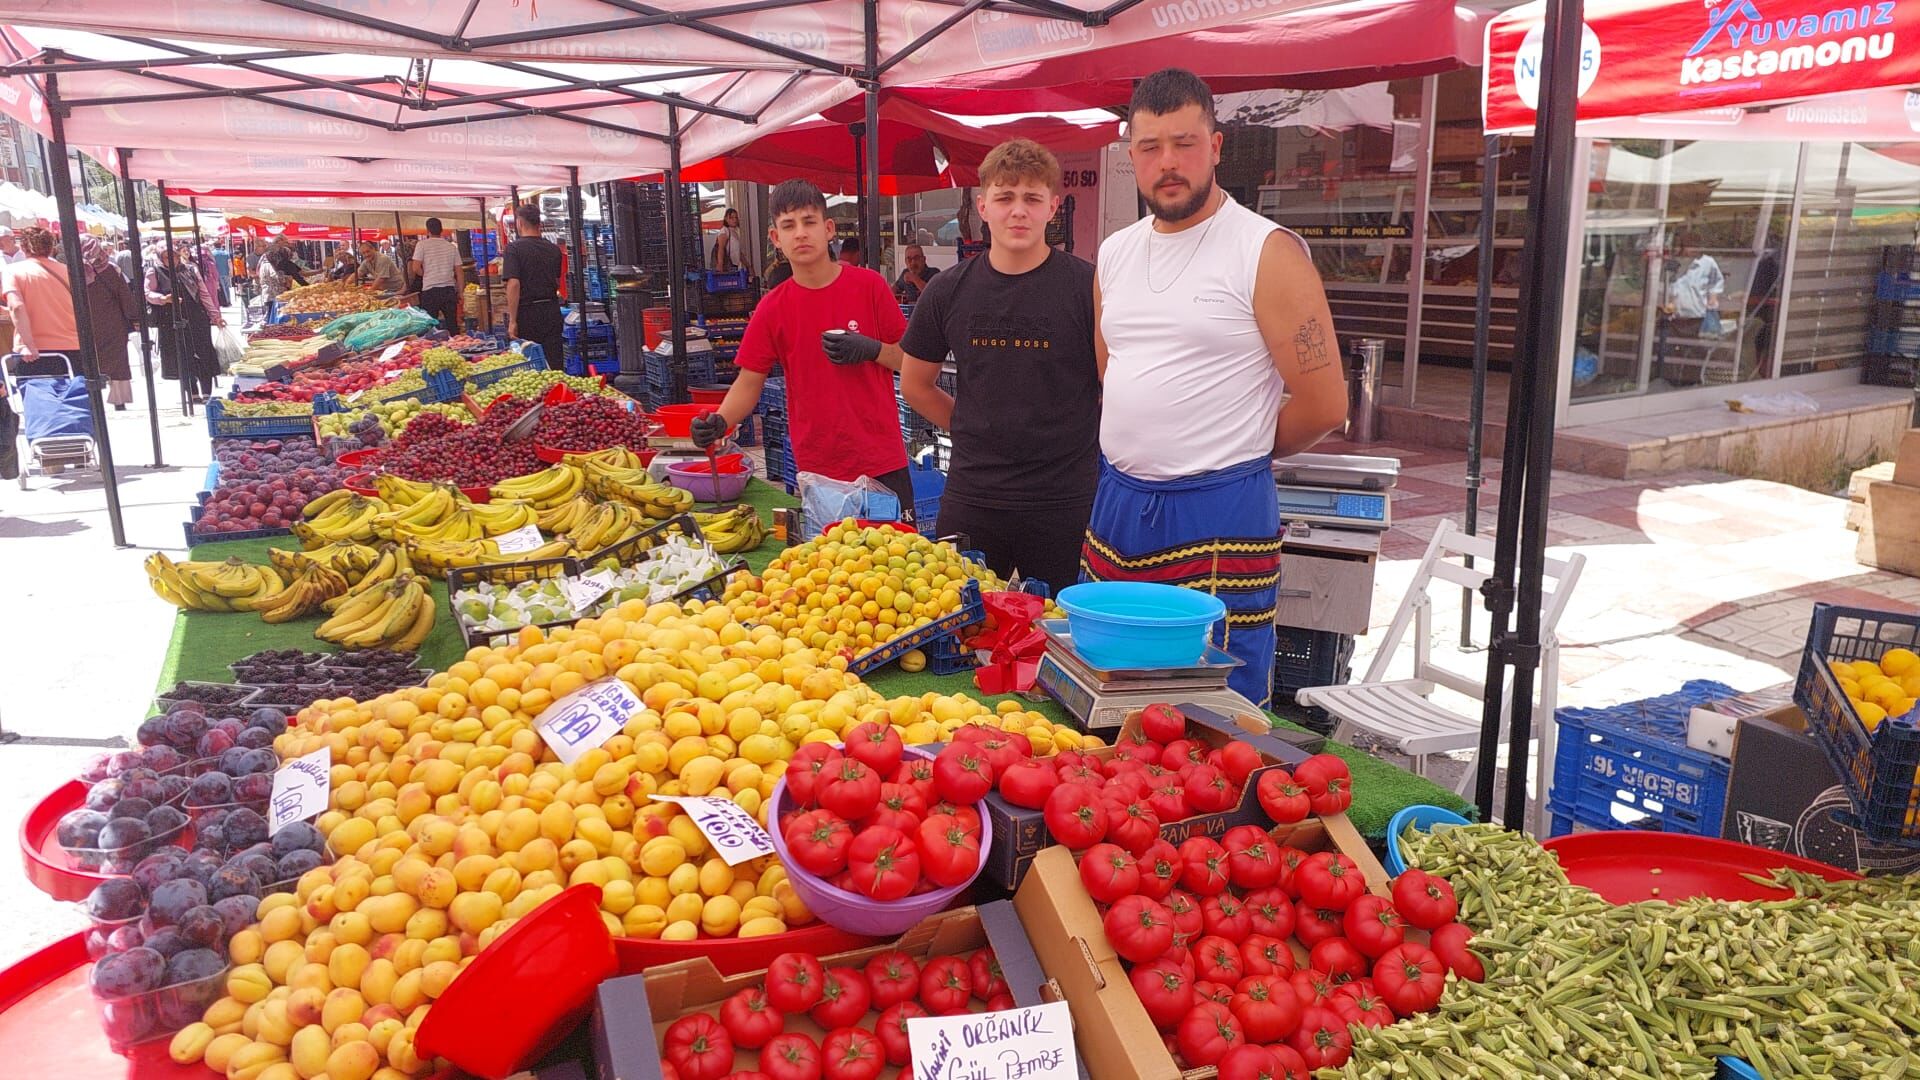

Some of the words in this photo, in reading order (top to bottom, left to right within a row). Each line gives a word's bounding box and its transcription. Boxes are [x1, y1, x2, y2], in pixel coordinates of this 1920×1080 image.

[1727, 1, 1896, 49] Yuvamız
[1679, 32, 1895, 86] Kastamonu
[972, 337, 1007, 347] HUGO
[1014, 338, 1049, 349] BOSS
[1592, 754, 1617, 778] 16
[697, 811, 744, 848] 100
